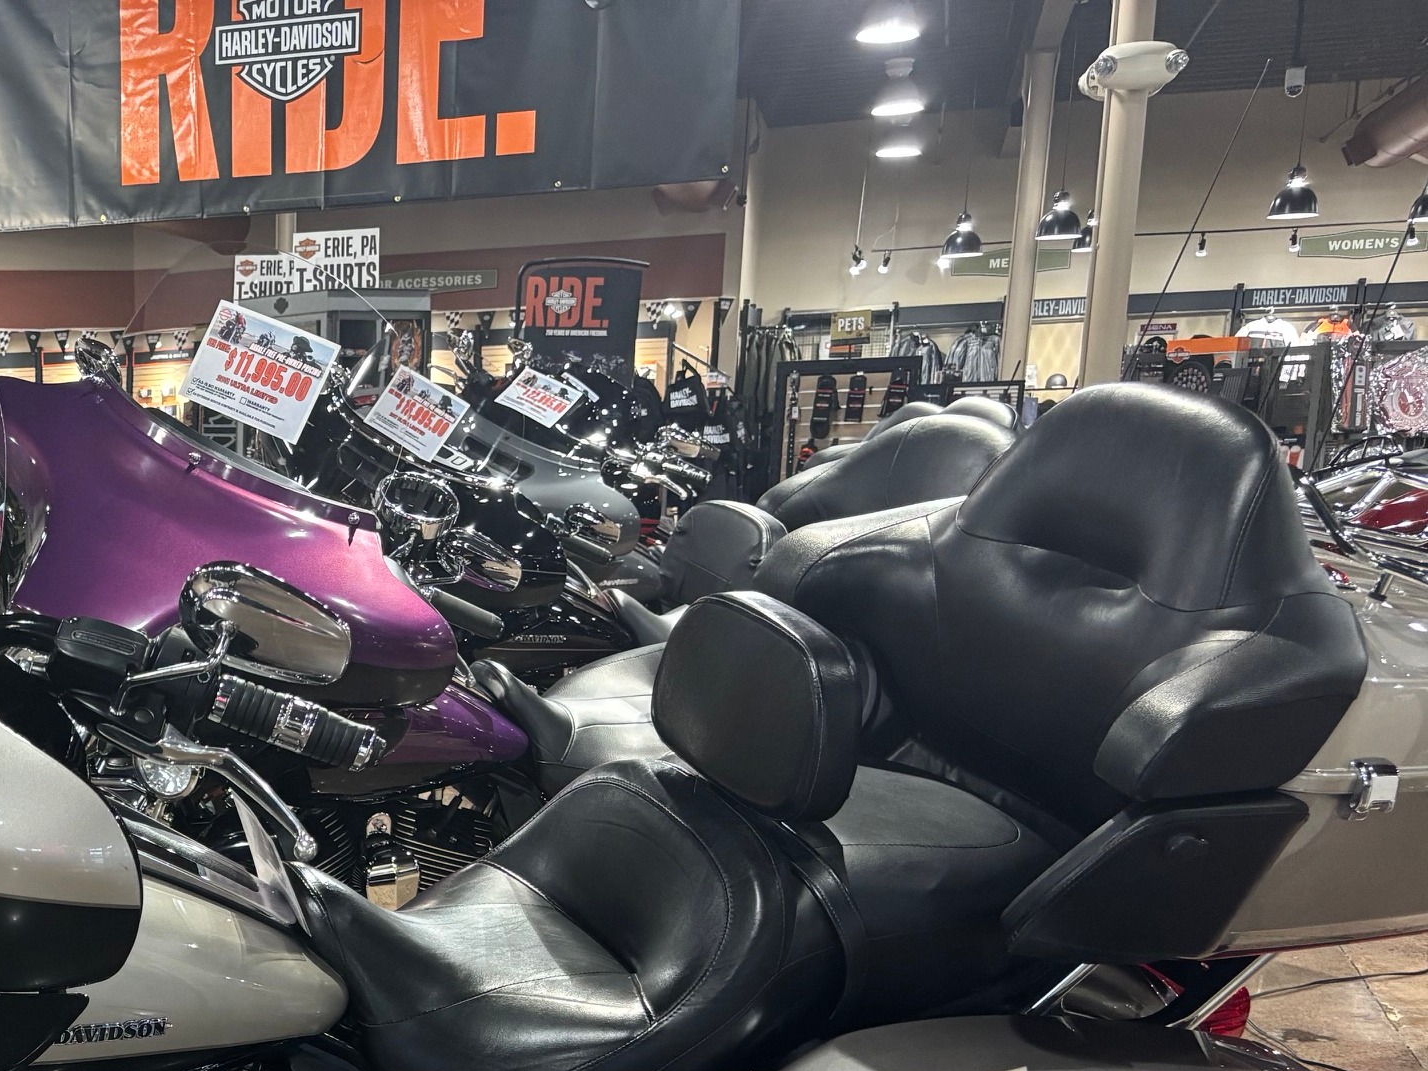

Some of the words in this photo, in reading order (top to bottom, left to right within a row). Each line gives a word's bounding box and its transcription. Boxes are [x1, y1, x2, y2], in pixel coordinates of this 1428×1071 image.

[222, 20, 352, 57] HARLEY-DAVIDSON
[252, 58, 320, 93] CYCLES
[324, 236, 358, 260] ERIE,
[361, 235, 377, 256] PA
[1328, 238, 1400, 251] WOMEN'S
[260, 260, 286, 277] ERIE,
[296, 262, 378, 291] T-SHIRTS
[236, 280, 294, 299] T-SHIRT
[397, 275, 483, 289] ACCESSORIES
[525, 276, 609, 328] RIDE.
[1252, 287, 1348, 306] HARLEY-DAVIDSON
[837, 316, 865, 332] PETS
